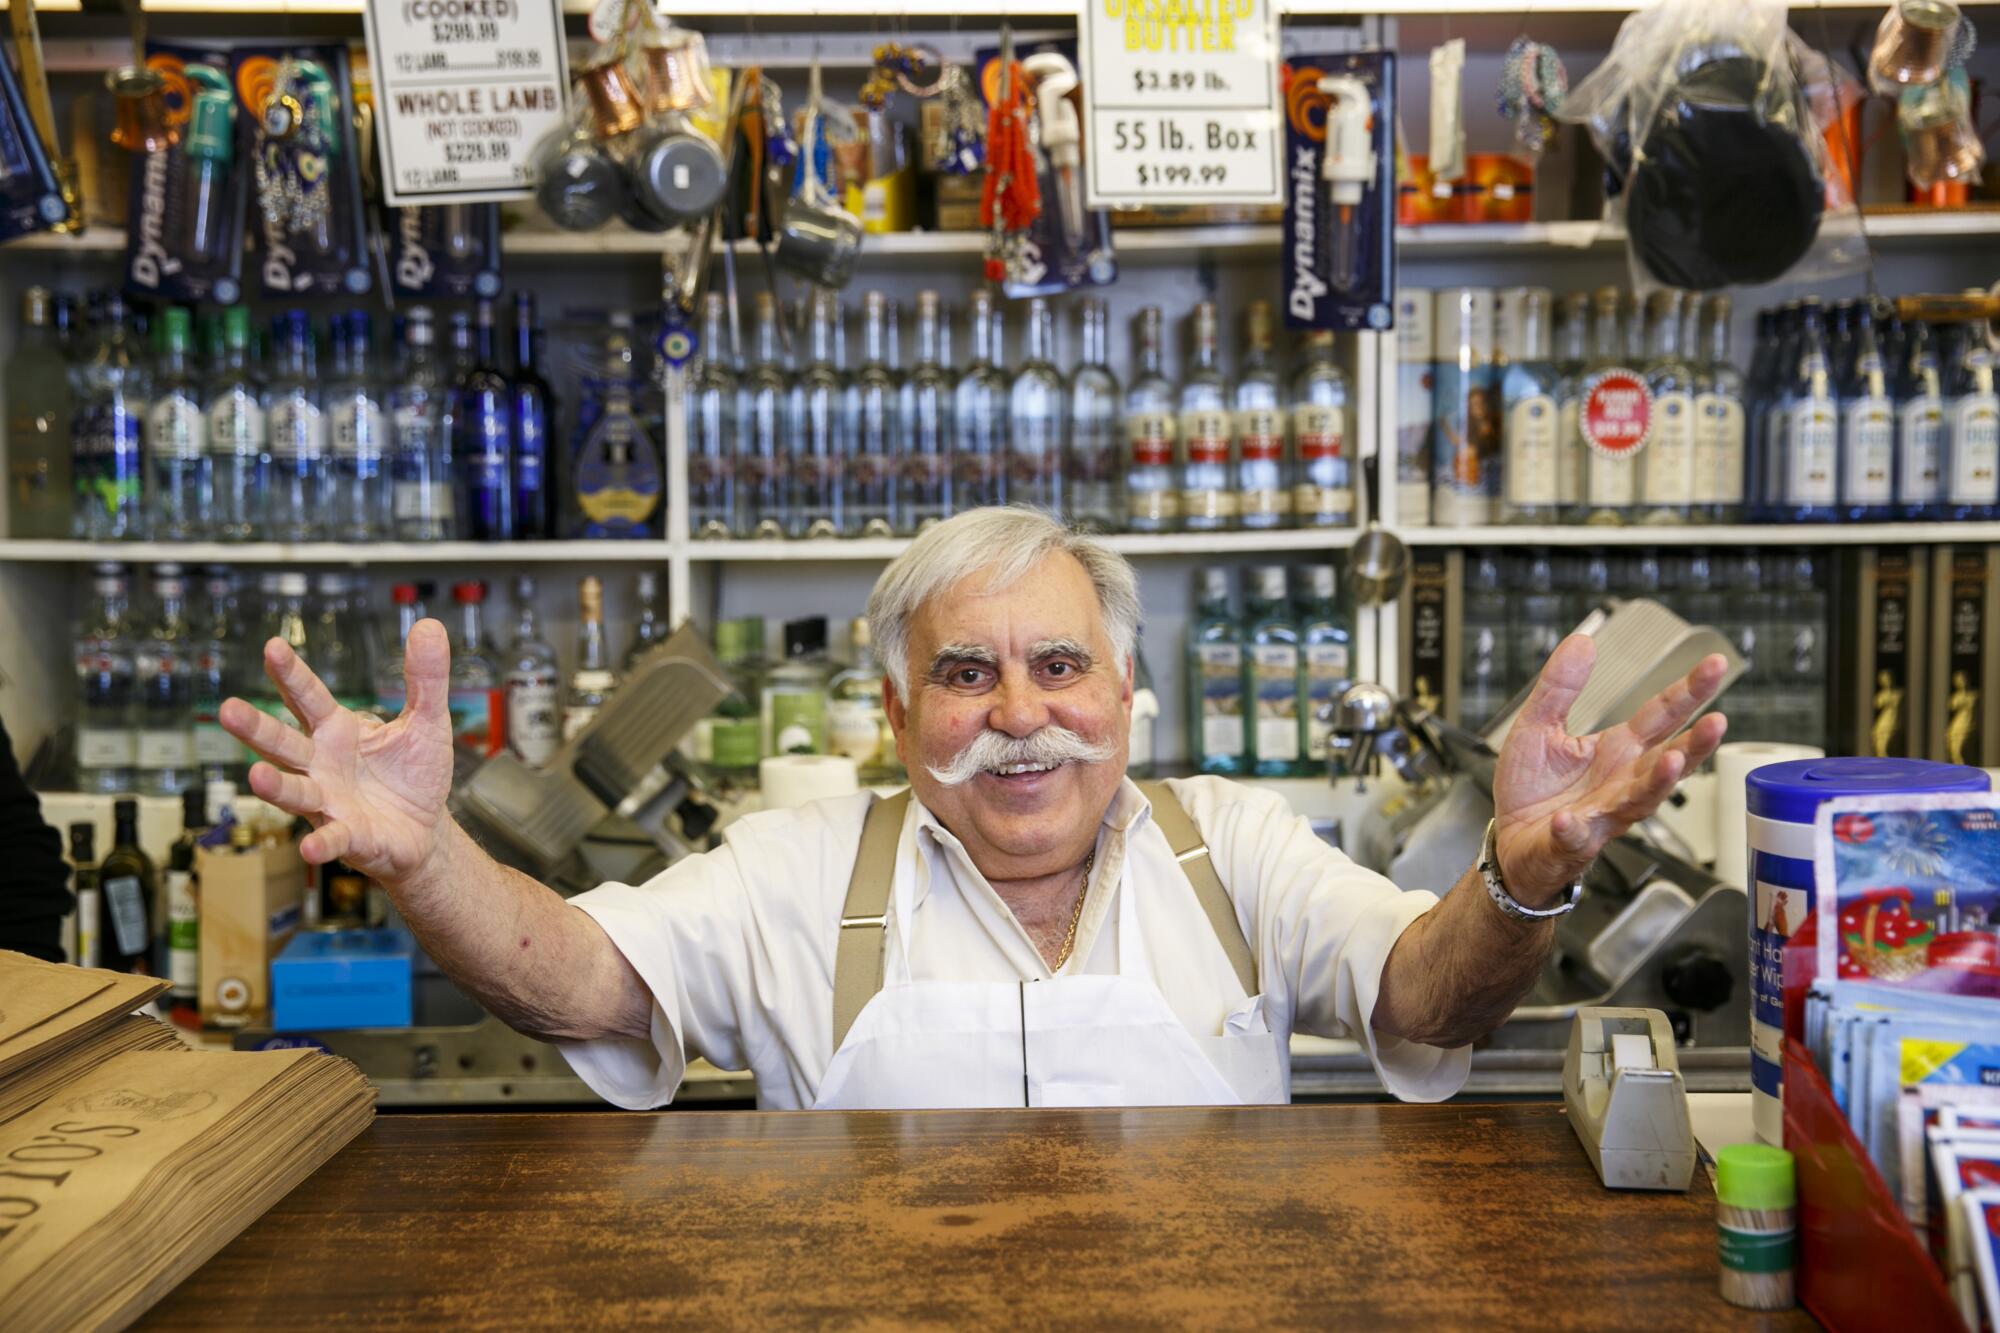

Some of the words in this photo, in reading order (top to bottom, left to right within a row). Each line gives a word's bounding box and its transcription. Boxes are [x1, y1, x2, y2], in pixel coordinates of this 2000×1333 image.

[401, 0, 519, 25] (COOKED)
[1125, 20, 1236, 52] BUTTER
[1134, 70, 1195, 91] $3.89
[1203, 71, 1231, 91] lb.
[396, 89, 484, 115] WHOLE
[491, 87, 557, 111] LAMB
[1115, 121, 1147, 151] 55
[1159, 119, 1194, 151] lb.
[1206, 122, 1257, 150] Box
[1137, 164, 1227, 186] $199.99
[1289, 147, 1327, 321] Dynamix
